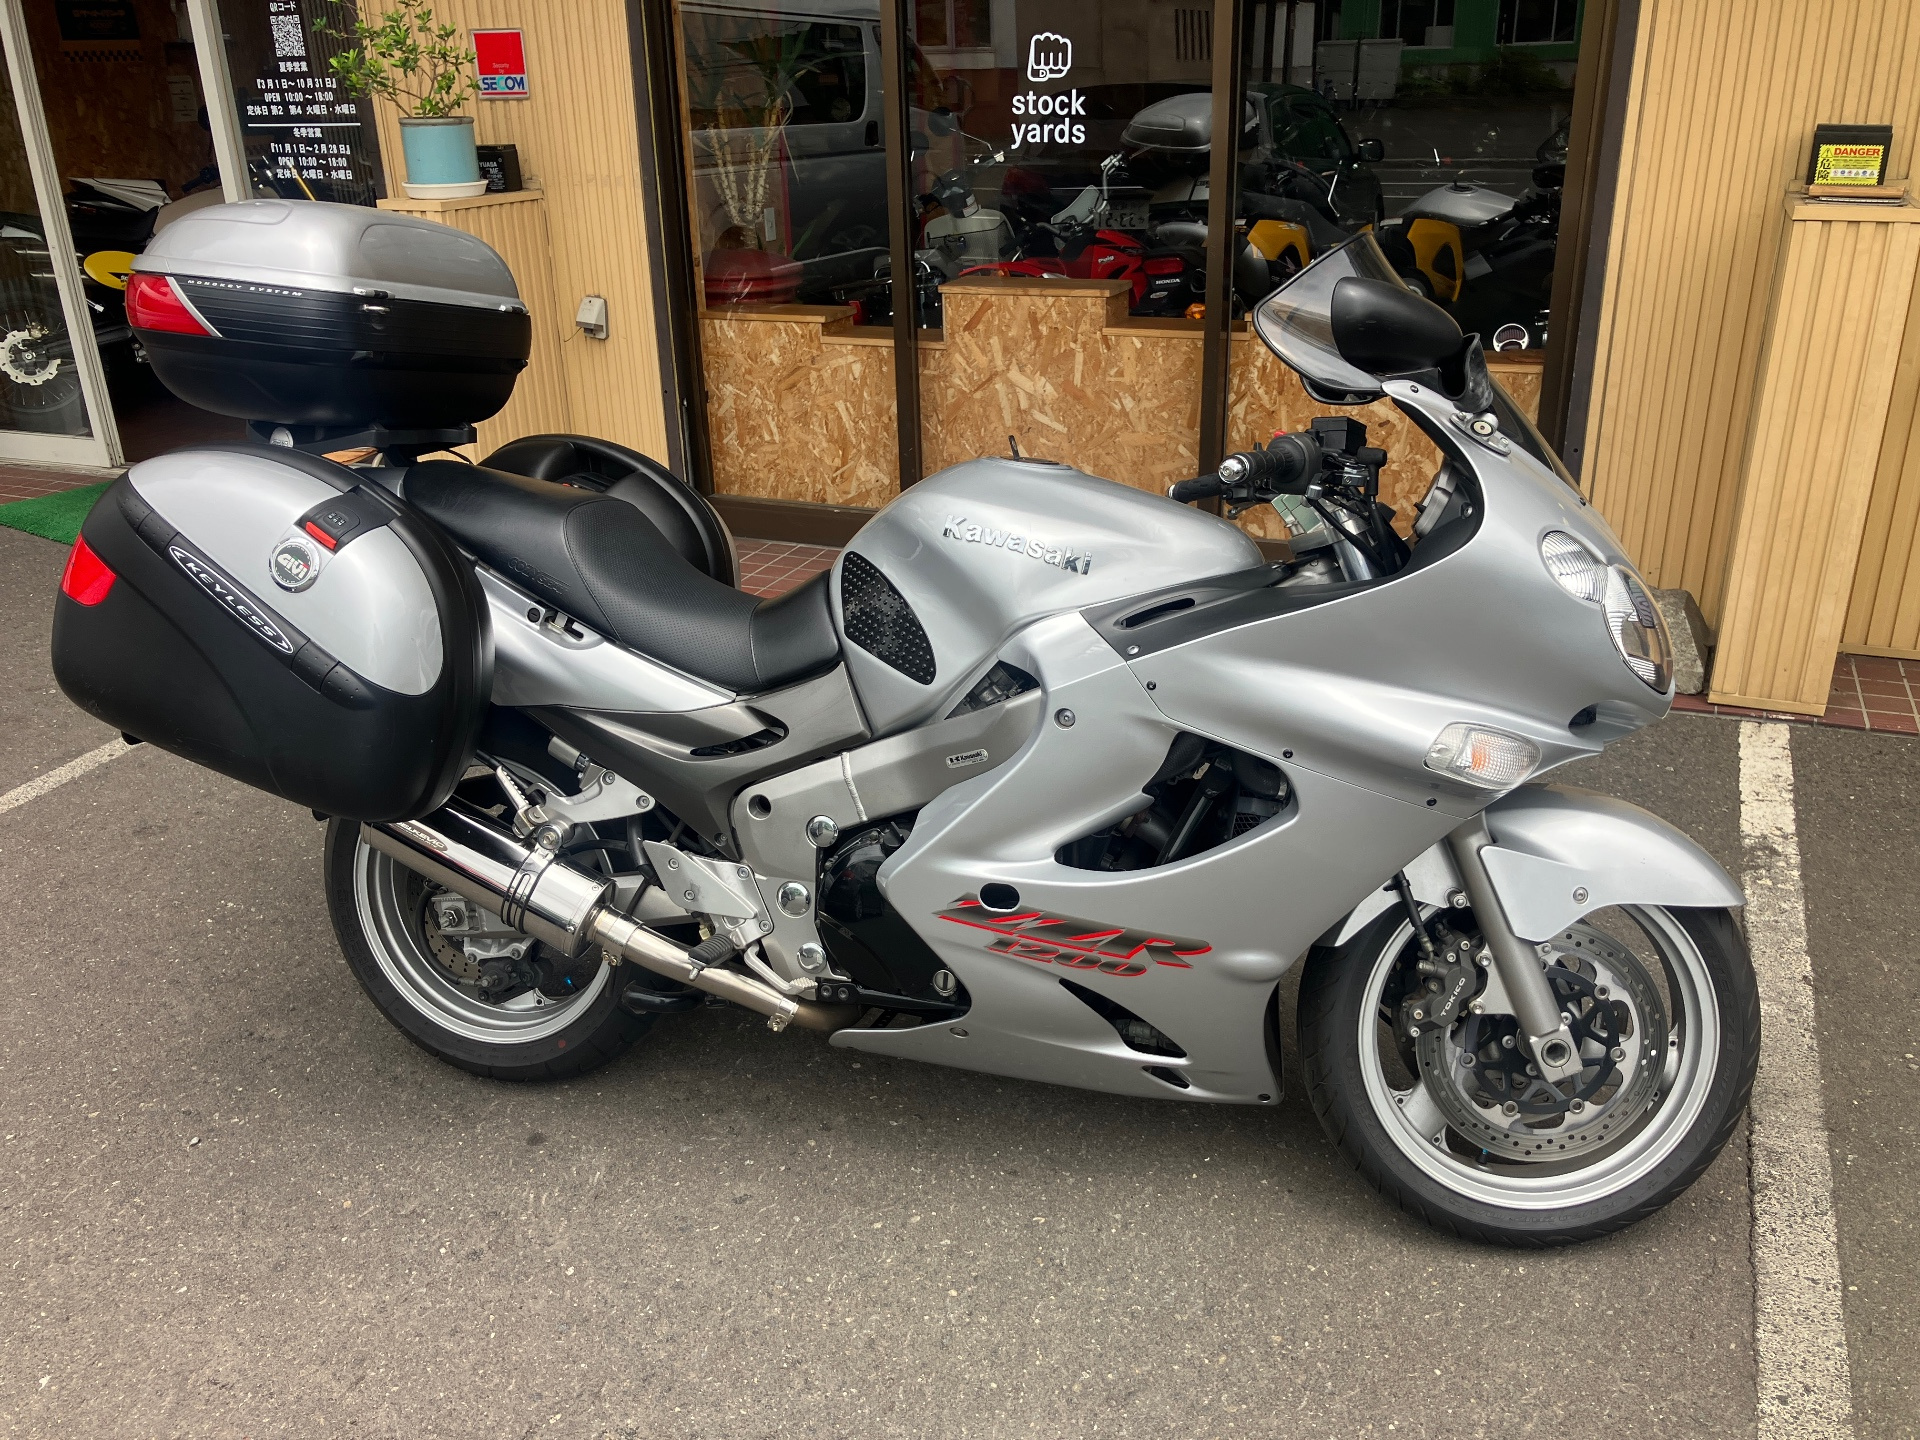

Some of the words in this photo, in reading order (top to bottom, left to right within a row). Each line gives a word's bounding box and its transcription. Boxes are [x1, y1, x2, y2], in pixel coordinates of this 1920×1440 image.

[270, 1, 296, 12] QRコード
[278, 61, 308, 73] 夏季営業
[482, 76, 525, 91] SECOM
[264, 92, 281, 103] OPEN
[284, 91, 304, 102] 10:00
[314, 91, 334, 101] 18:00
[1011, 88, 1087, 116] stock
[246, 104, 269, 116] 定休日
[293, 127, 323, 138] 冬季営業
[1010, 117, 1086, 150] yards
[1833, 147, 1880, 156] DANGER
[278, 156, 295, 166] OPEN
[299, 156, 317, 167] 10:00
[328, 157, 347, 167] 18:00
[276, 169, 299, 179] 定休日
[249, 287, 303, 297] SYSTEM
[943, 514, 1092, 576] Kawasaki
[277, 553, 309, 579] GIVI
[186, 562, 277, 637] KEYLESS
[932, 892, 1213, 968] ZZR
[984, 938, 1147, 976] 1200
[1440, 977, 1466, 1017] TOKICO
